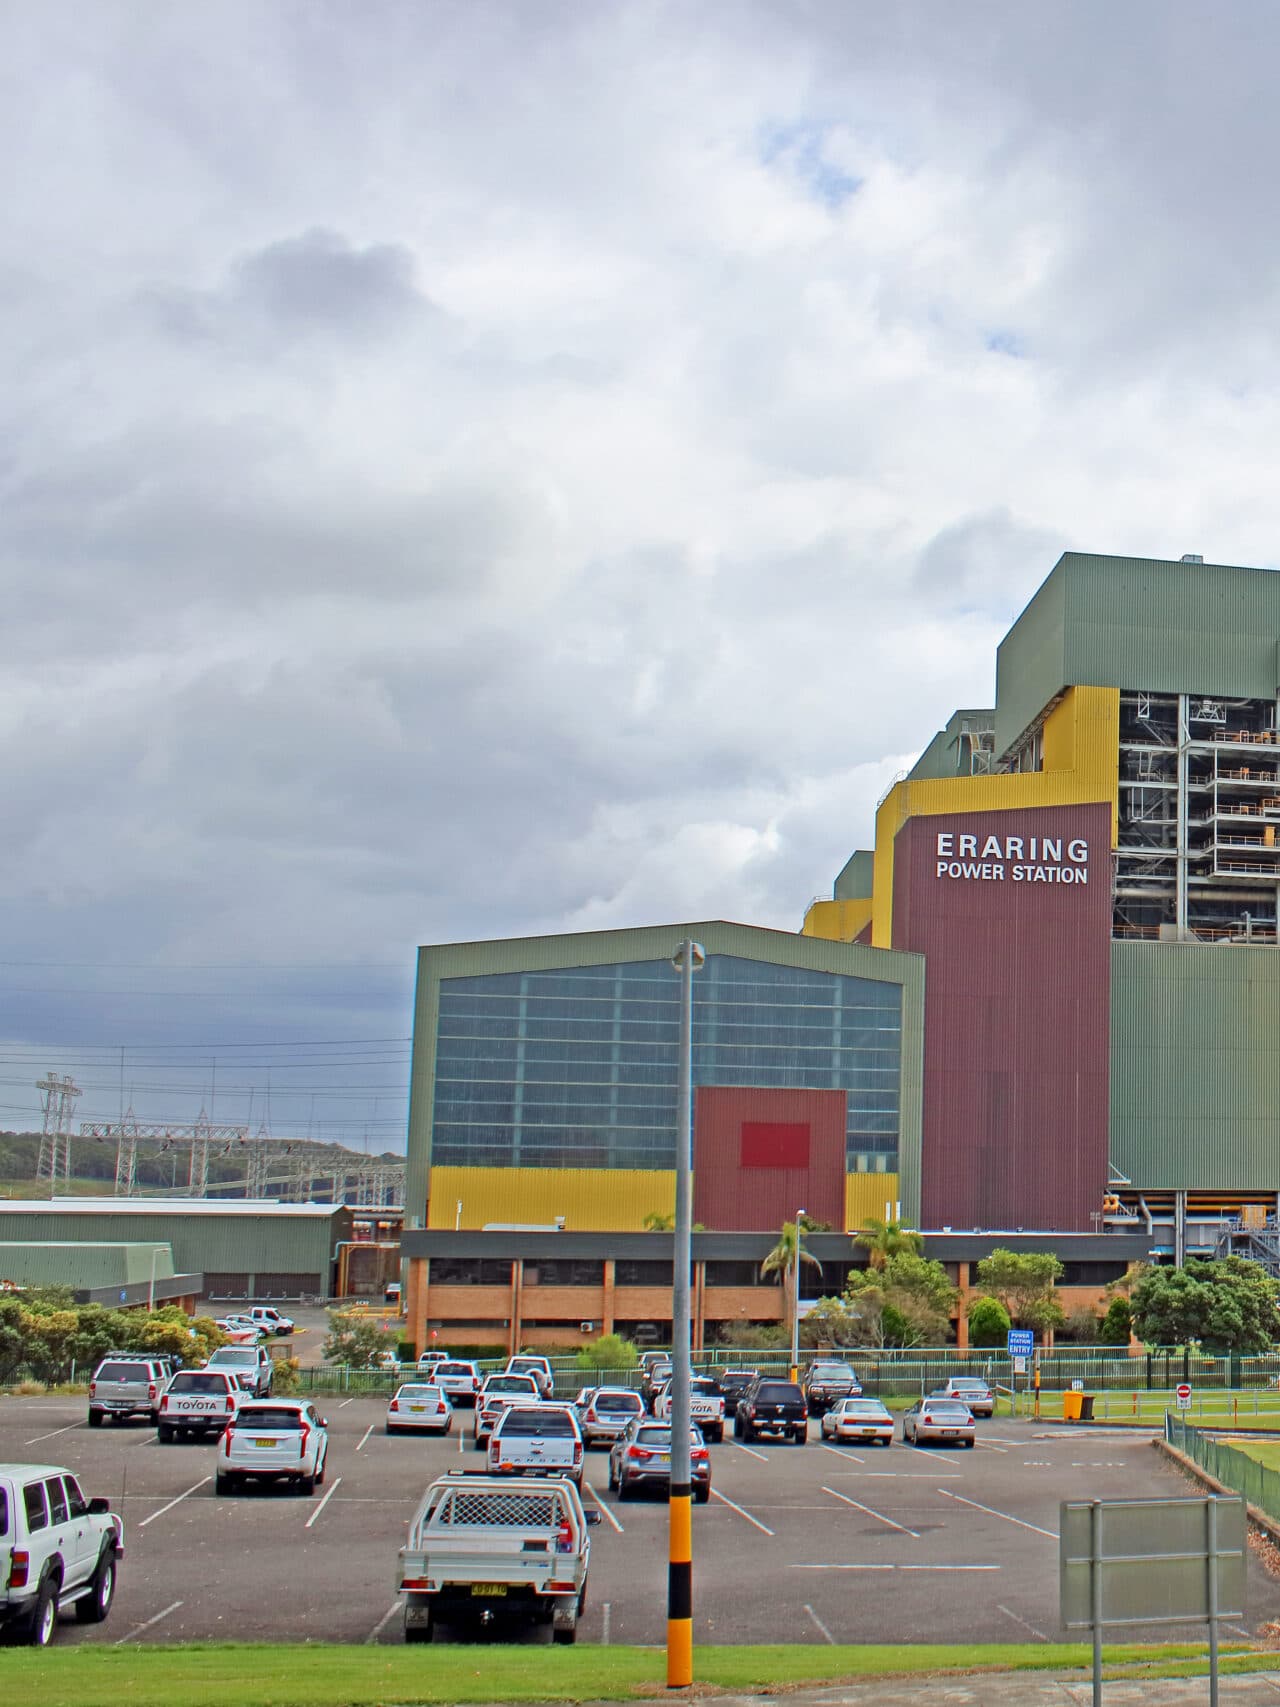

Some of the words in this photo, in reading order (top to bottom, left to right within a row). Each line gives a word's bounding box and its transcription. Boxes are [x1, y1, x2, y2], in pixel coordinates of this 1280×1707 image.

[936, 833, 1089, 863] ERARING
[936, 861, 1005, 881] POWER
[1011, 865, 1088, 884] STATION
[1010, 1345, 1031, 1354] ENTRY
[177, 1400, 217, 1411] TOYOTA
